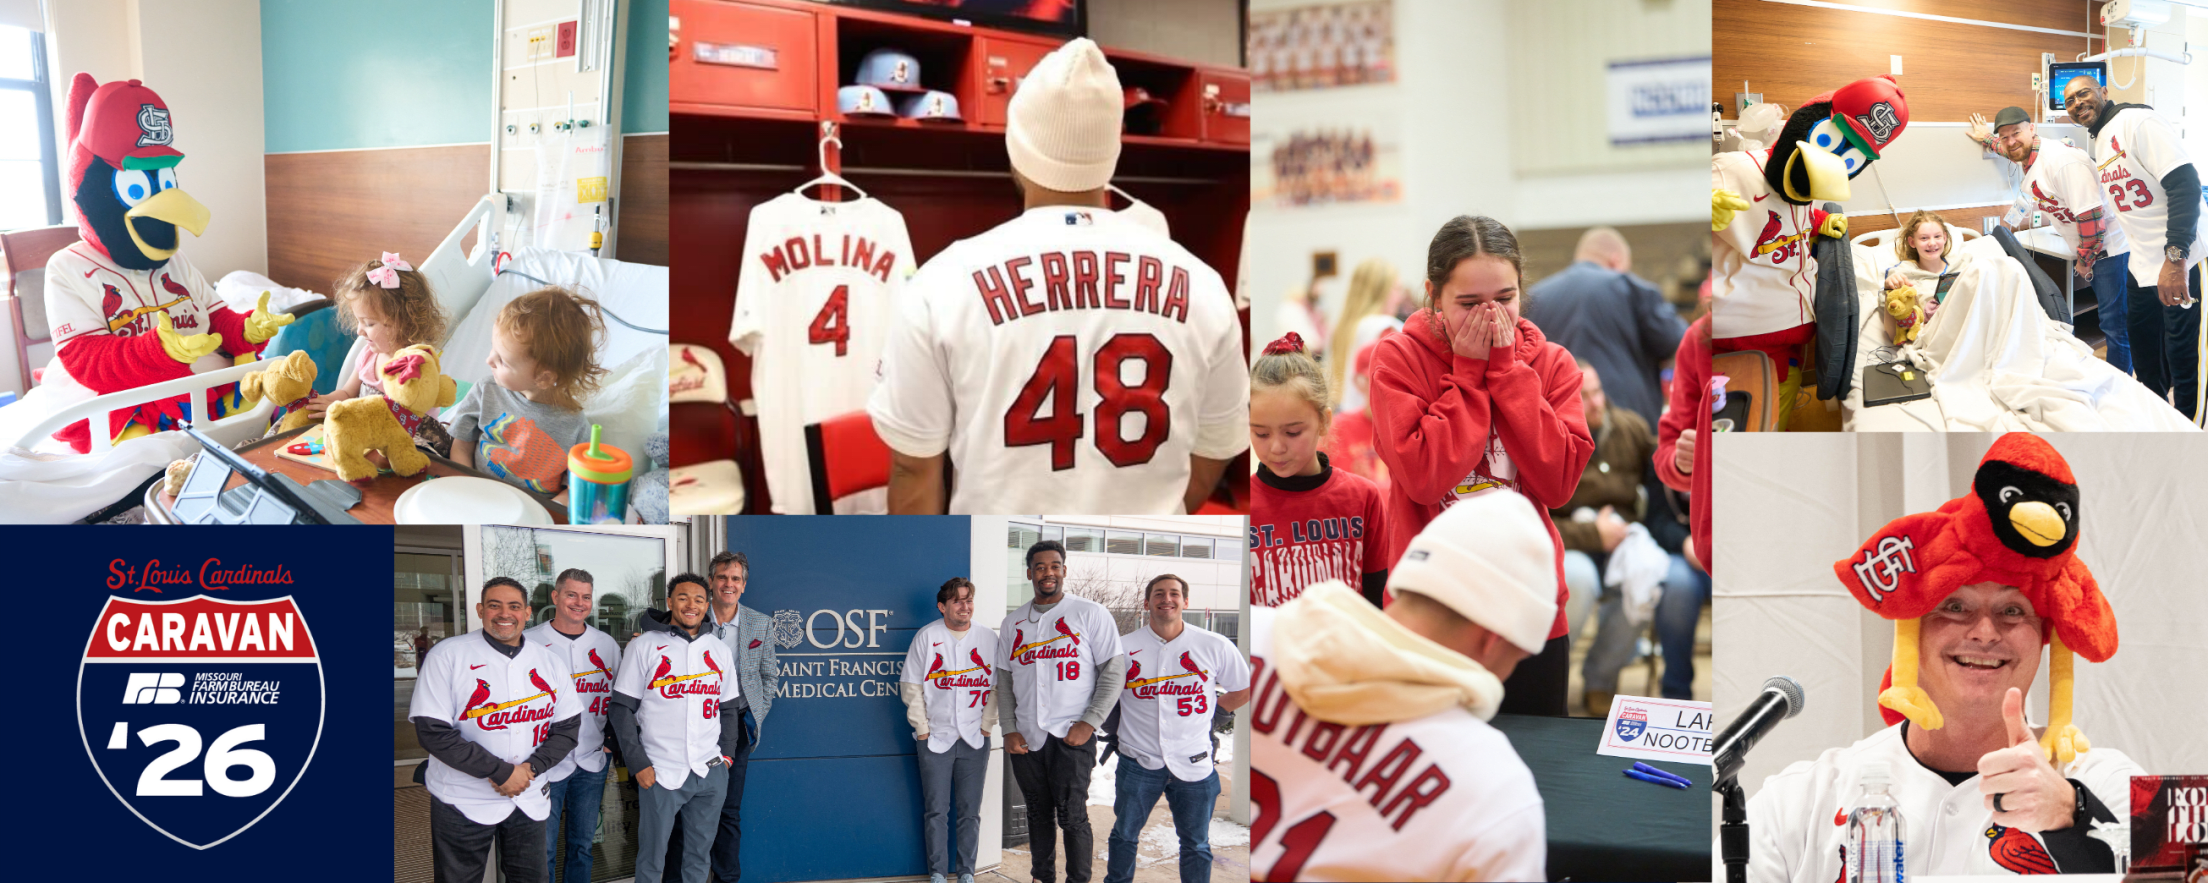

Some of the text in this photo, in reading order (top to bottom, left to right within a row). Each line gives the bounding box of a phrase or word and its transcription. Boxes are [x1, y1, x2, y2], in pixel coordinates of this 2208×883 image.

[2109, 178, 2154, 212] 23
[759, 234, 896, 283] MOLINA
[971, 250, 1190, 326] HERRERA
[808, 284, 850, 357] 4
[1004, 333, 1173, 472] 48
[1250, 516, 1364, 548] ST. LOUIS
[806, 609, 888, 649] OSF
[1018, 644, 1079, 666] Cardinals
[934, 670, 990, 690] Cardinals
[1056, 661, 1080, 681] 18
[1132, 678, 1205, 699] Cardinals
[477, 702, 555, 731] Cardinals
[1177, 694, 1208, 717] 53
[1621, 712, 1647, 721] CARAVAN
[532, 721, 550, 748] 18
[1893, 838, 1904, 883] water
